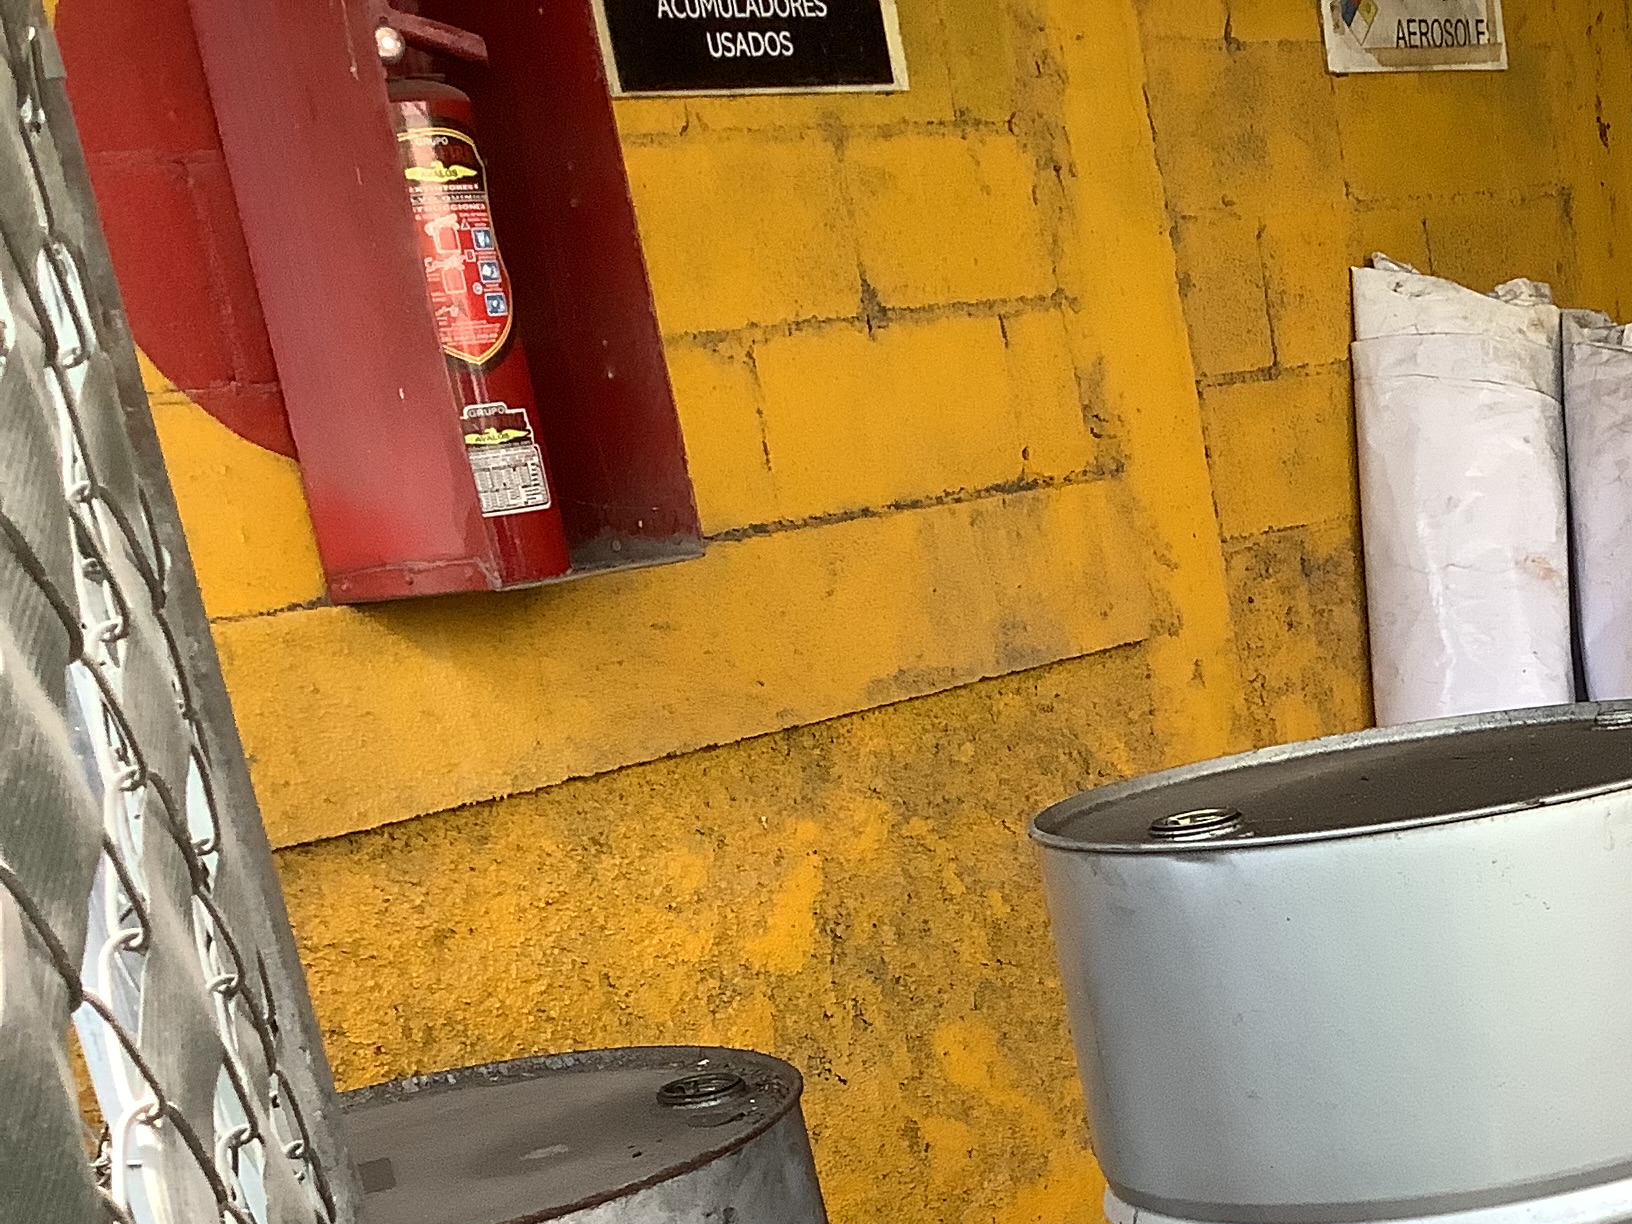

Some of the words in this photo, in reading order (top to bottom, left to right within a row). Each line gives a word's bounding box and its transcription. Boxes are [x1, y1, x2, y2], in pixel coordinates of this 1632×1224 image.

[658, 0, 828, 18] ACUMULADORES
[706, 31, 794, 57] USADOS
[1396, 18, 1490, 48] AEROSOLE
[467, 405, 506, 418] GRUPO
